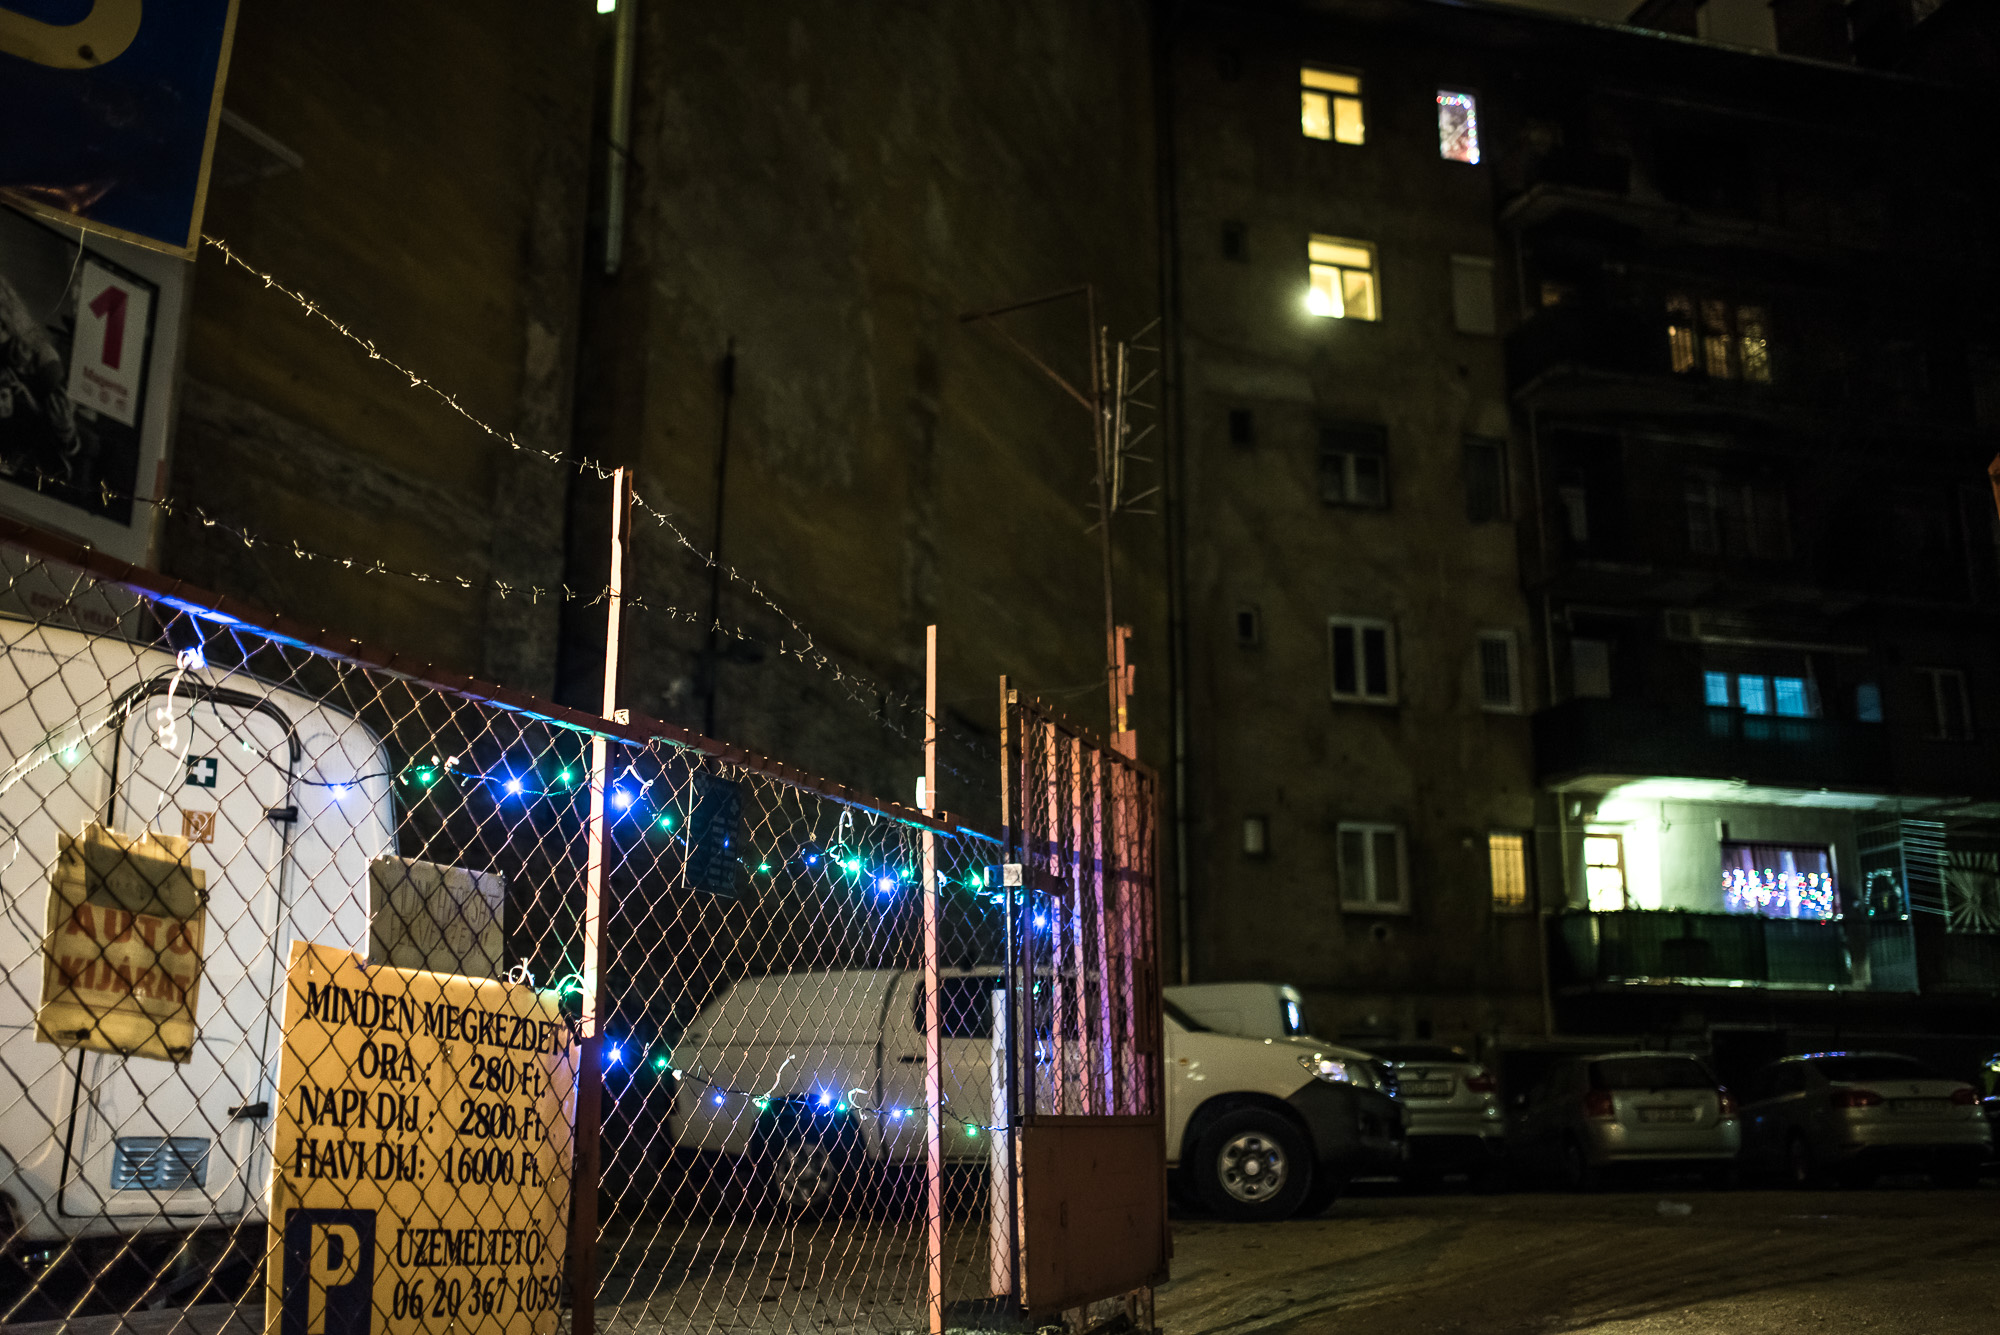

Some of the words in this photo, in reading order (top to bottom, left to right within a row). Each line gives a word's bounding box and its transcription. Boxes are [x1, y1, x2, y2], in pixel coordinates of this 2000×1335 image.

[89, 286, 127, 370] 1
[65, 902, 193, 956] AUTO
[57, 956, 191, 1004] KIJÁRAT
[304, 981, 416, 1035] MINDEN
[469, 1053, 515, 1094] 280
[521, 1062, 546, 1099] Ft.
[297, 1085, 368, 1129] NAPI
[458, 1099, 516, 1140] 2800
[294, 1138, 366, 1180] HAVI
[444, 1147, 514, 1186] 16000
[307, 1222, 361, 1334] P
[393, 1279, 425, 1321] 06
[432, 1277, 462, 1318] 20
[468, 1276, 508, 1317] 367
[515, 1275, 562, 1313] 1059
